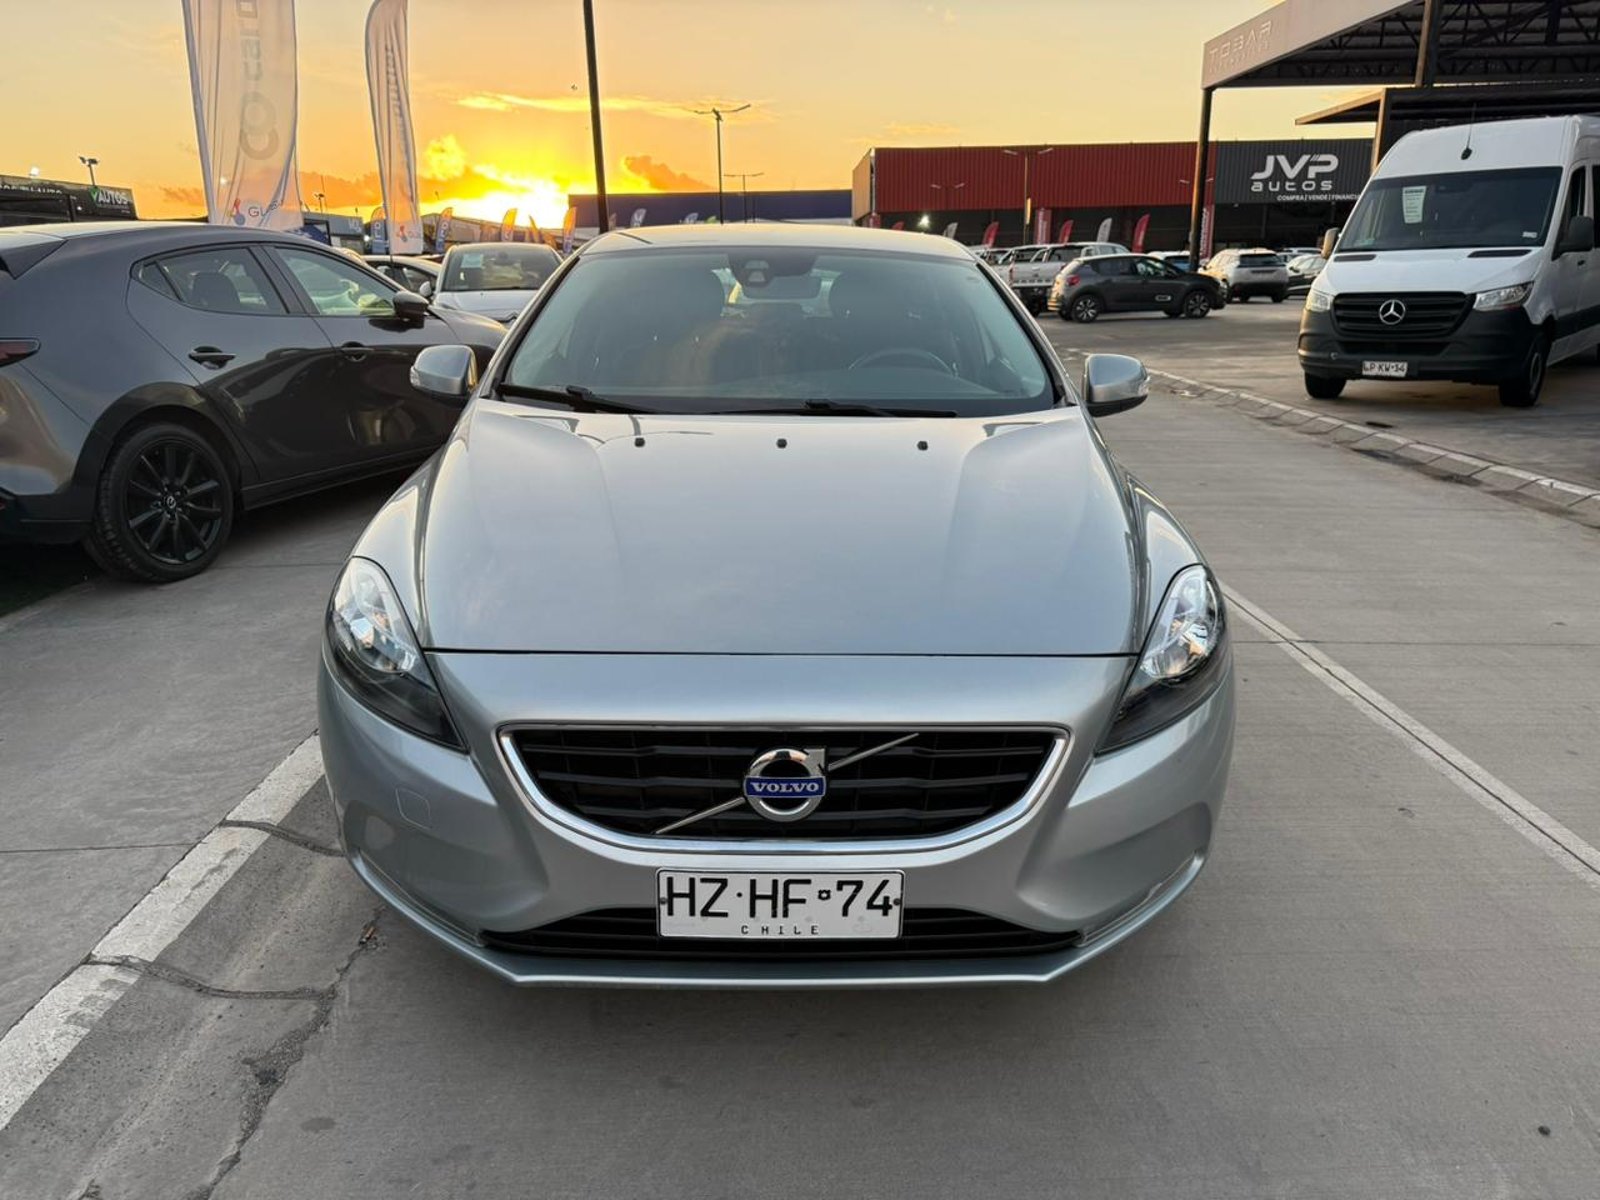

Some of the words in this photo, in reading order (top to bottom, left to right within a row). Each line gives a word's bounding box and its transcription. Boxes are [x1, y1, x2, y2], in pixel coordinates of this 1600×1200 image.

[1251, 154, 1339, 179] JVP
[1250, 180, 1333, 192] autos
[750, 781, 819, 792] VOLVO
[740, 925, 819, 936] CHILE
